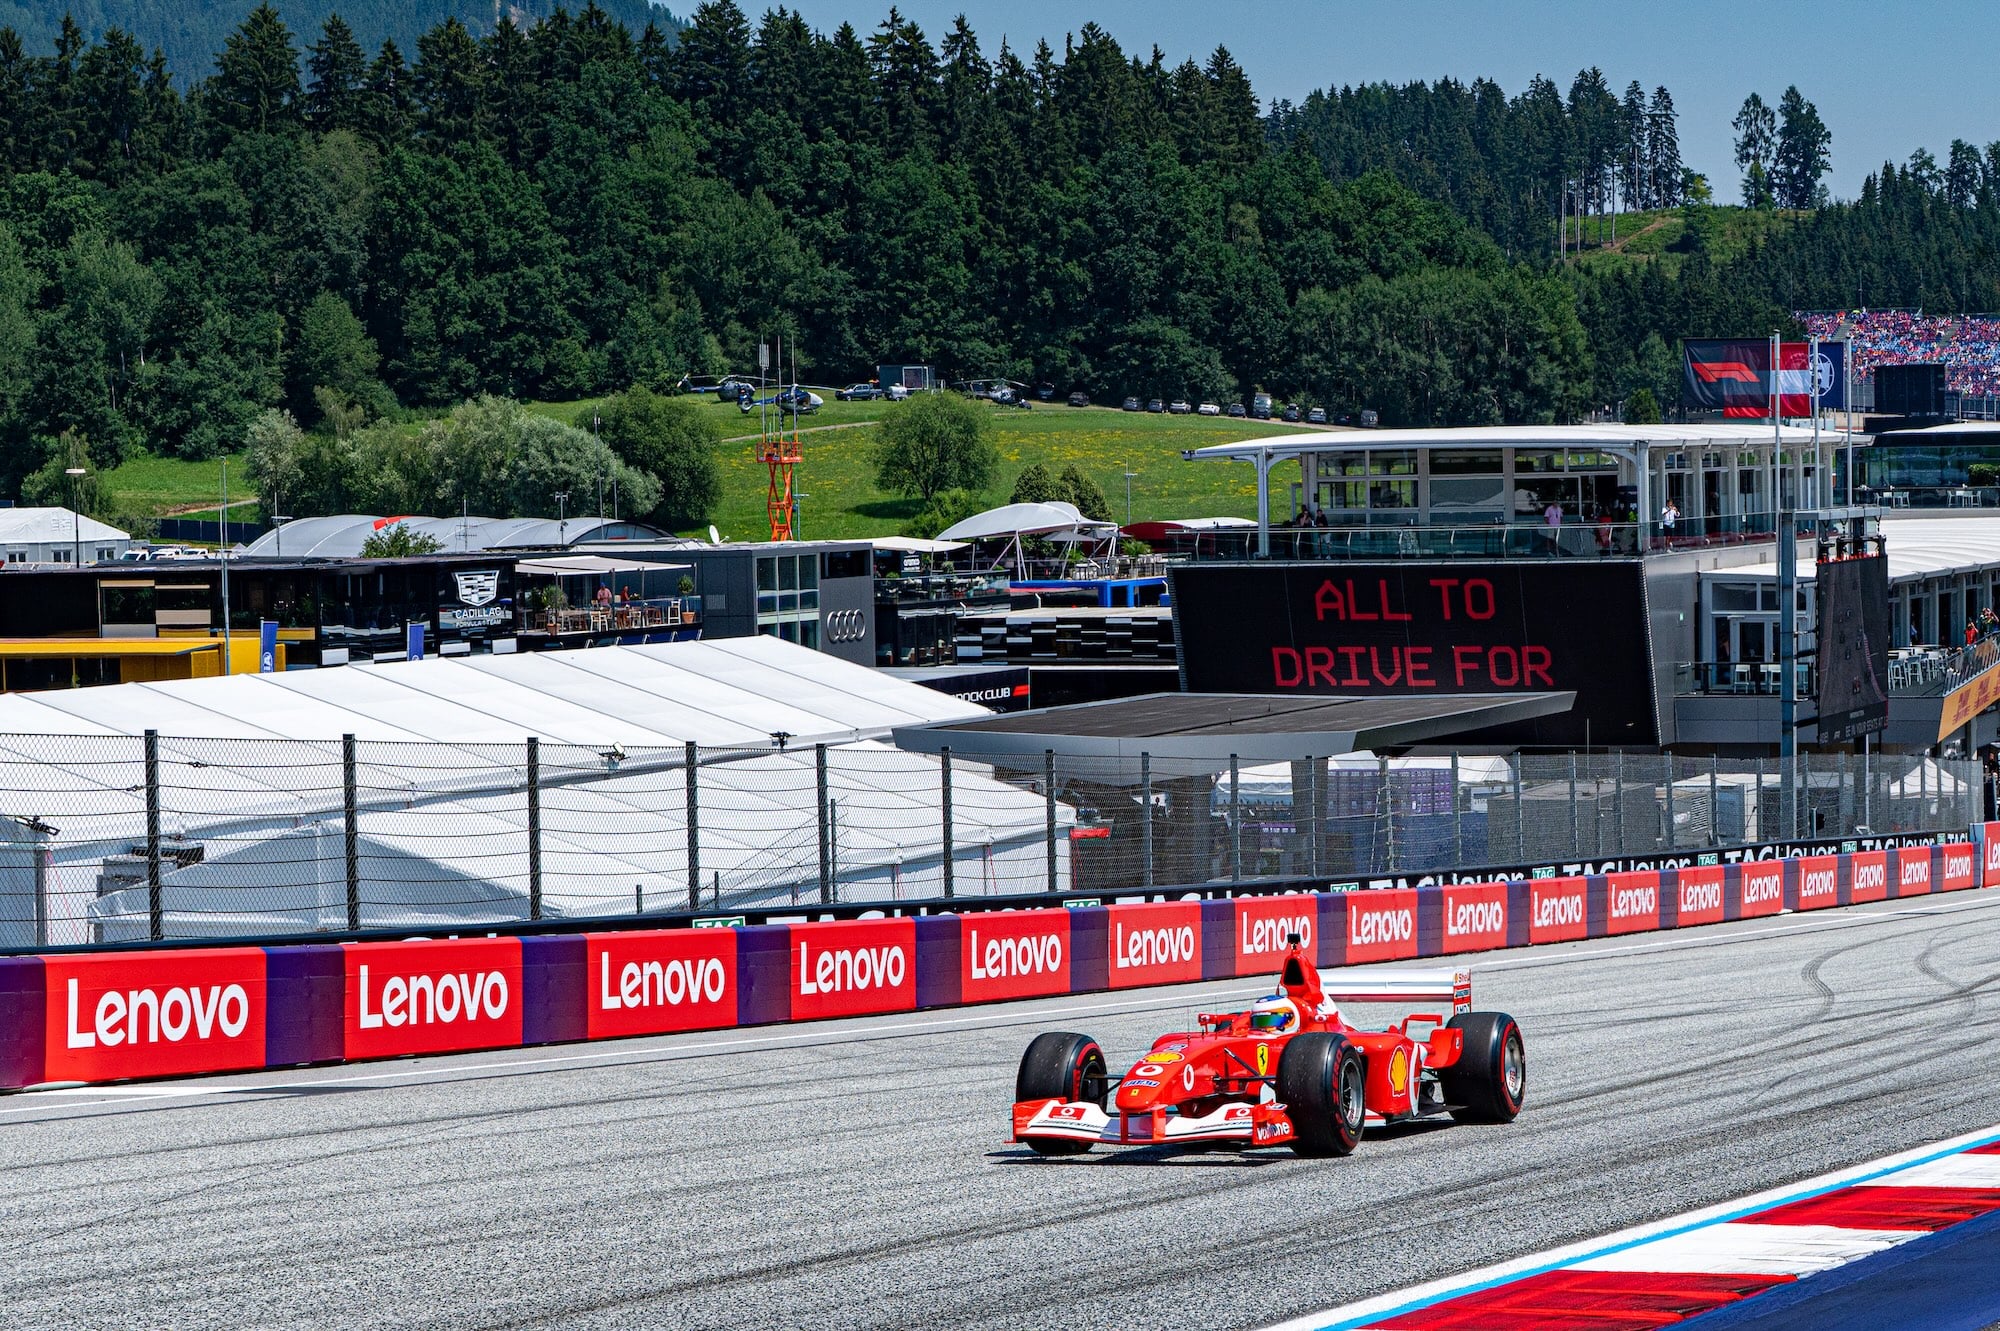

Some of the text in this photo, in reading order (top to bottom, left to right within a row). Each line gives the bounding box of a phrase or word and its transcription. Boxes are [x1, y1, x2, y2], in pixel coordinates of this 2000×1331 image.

[455, 606, 501, 619] CADILLAC
[1315, 578, 1495, 621] ALL TO
[1272, 646, 1554, 687] DRIVE FOR
[985, 687, 1011, 700] CLUB
[1534, 869, 1554, 880] TAG
[1700, 855, 1717, 866] TAG
[1855, 862, 1883, 889] Lenovo
[1902, 859, 1928, 884] Lenovo
[1946, 854, 1970, 879] Lenovo
[1681, 880, 1720, 912] Lenovo
[1745, 874, 1779, 903] Lenovo
[1802, 869, 1834, 896] Lenovo
[1448, 897, 1502, 935] Lenovo
[1534, 892, 1582, 927] Lenovo
[1612, 884, 1655, 917] Lenovo
[1352, 906, 1412, 944] Lenovo
[972, 931, 1061, 979] Lenovo
[1117, 923, 1194, 968] Lenovo
[602, 952, 724, 1009] Lenovo
[801, 942, 904, 994] Lenovo
[68, 979, 248, 1048] Lenovo
[360, 965, 507, 1028] Lenovo
